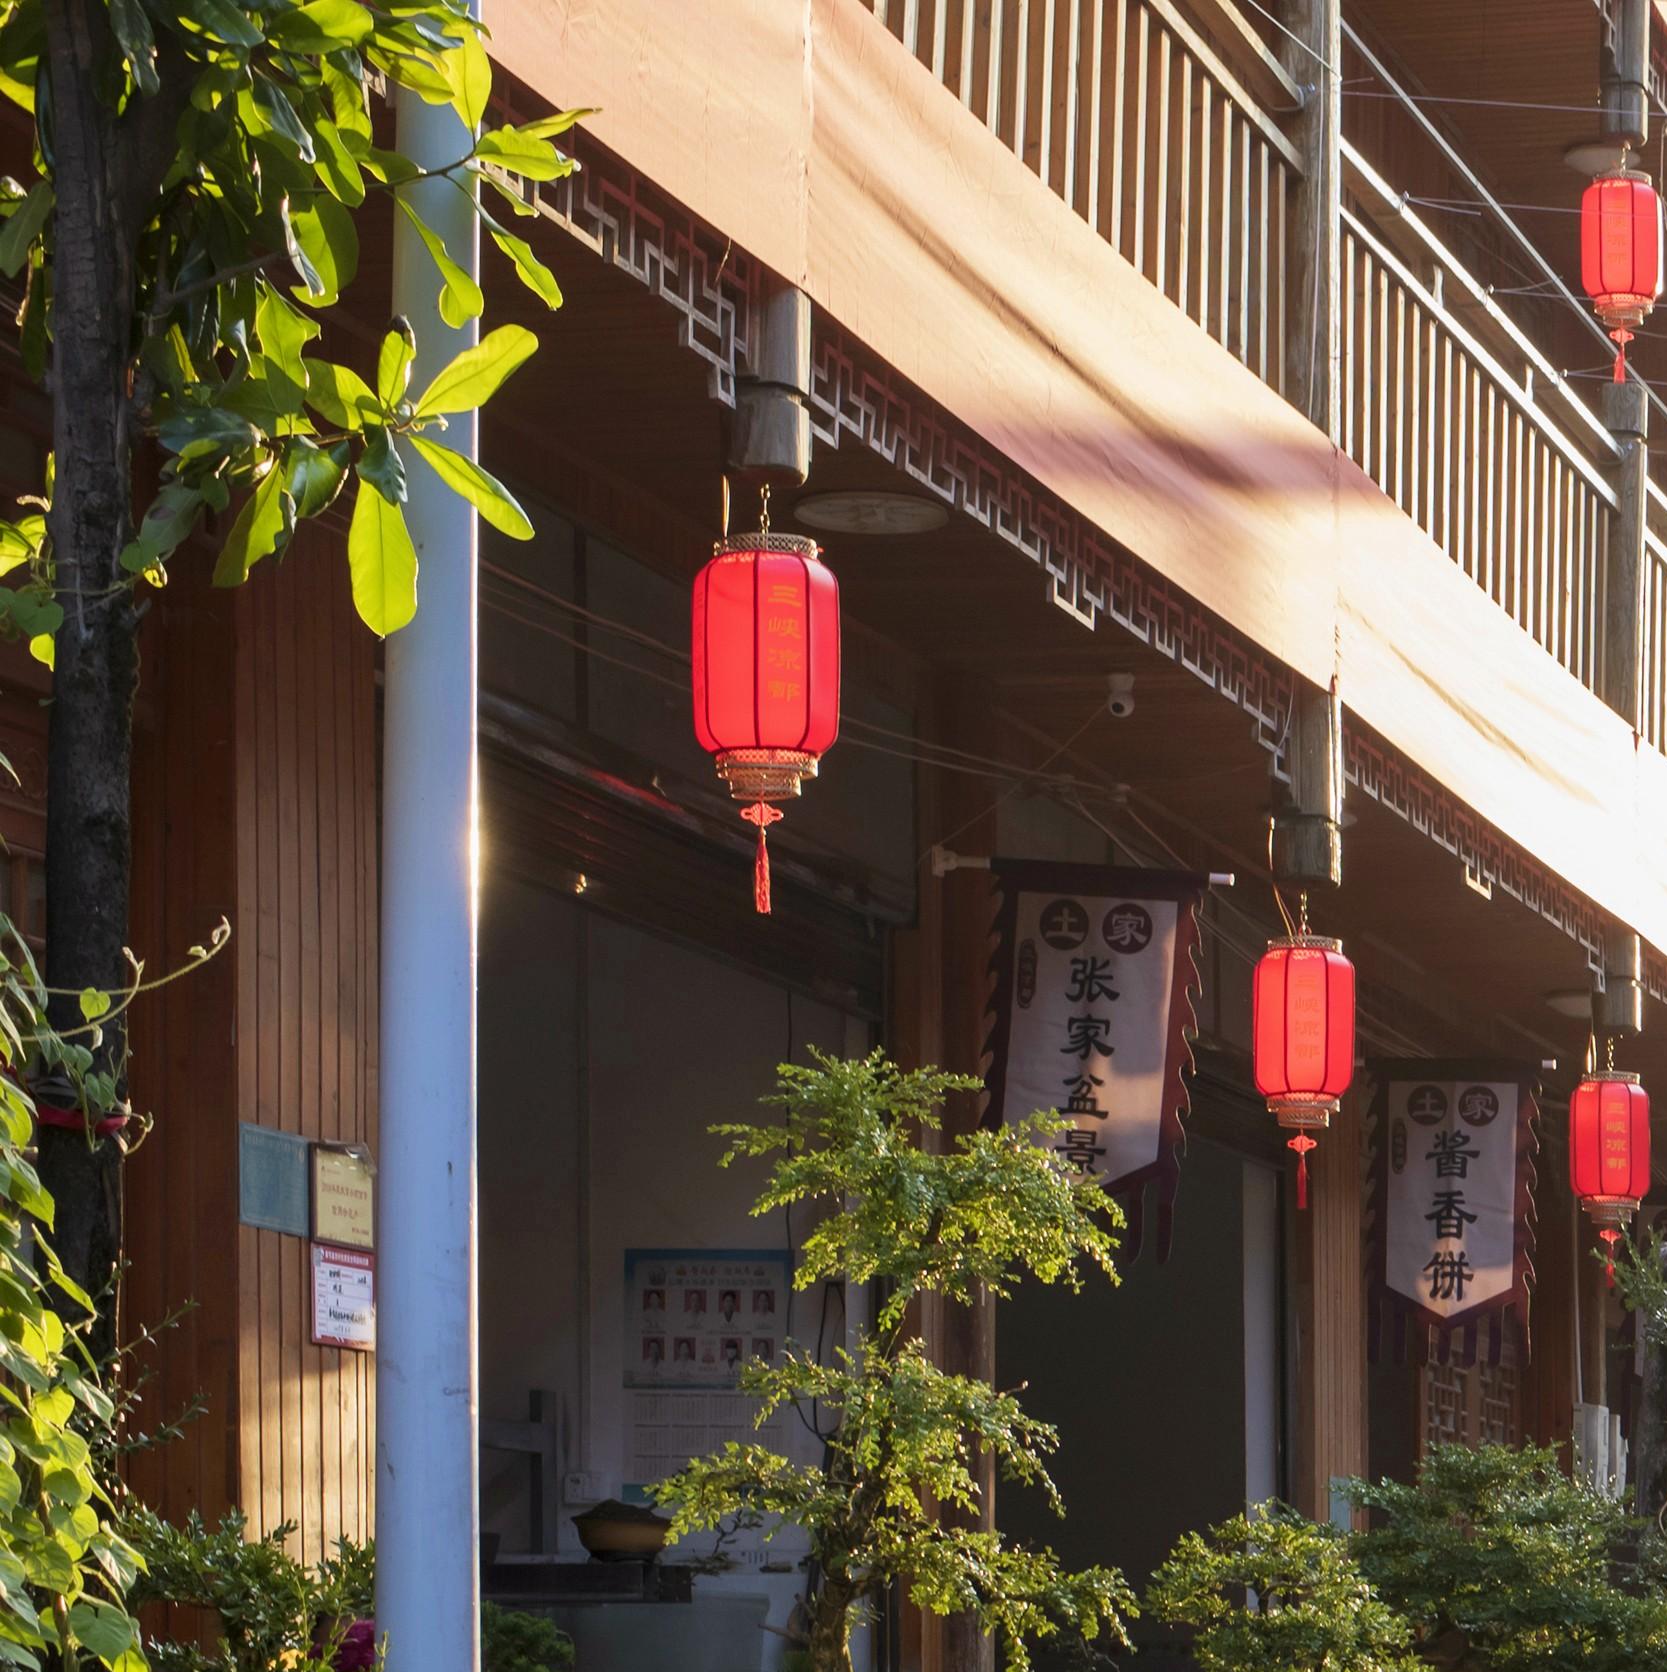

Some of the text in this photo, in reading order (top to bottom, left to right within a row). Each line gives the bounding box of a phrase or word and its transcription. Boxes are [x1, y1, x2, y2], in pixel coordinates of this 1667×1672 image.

[767, 584, 802, 702] 三峡凉都
[1045, 906, 1147, 946] 土家
[1053, 957, 1121, 1176] 张家盆景
[1411, 1090, 1494, 1119] 土家
[1422, 1129, 1480, 1302] 酱香饼
